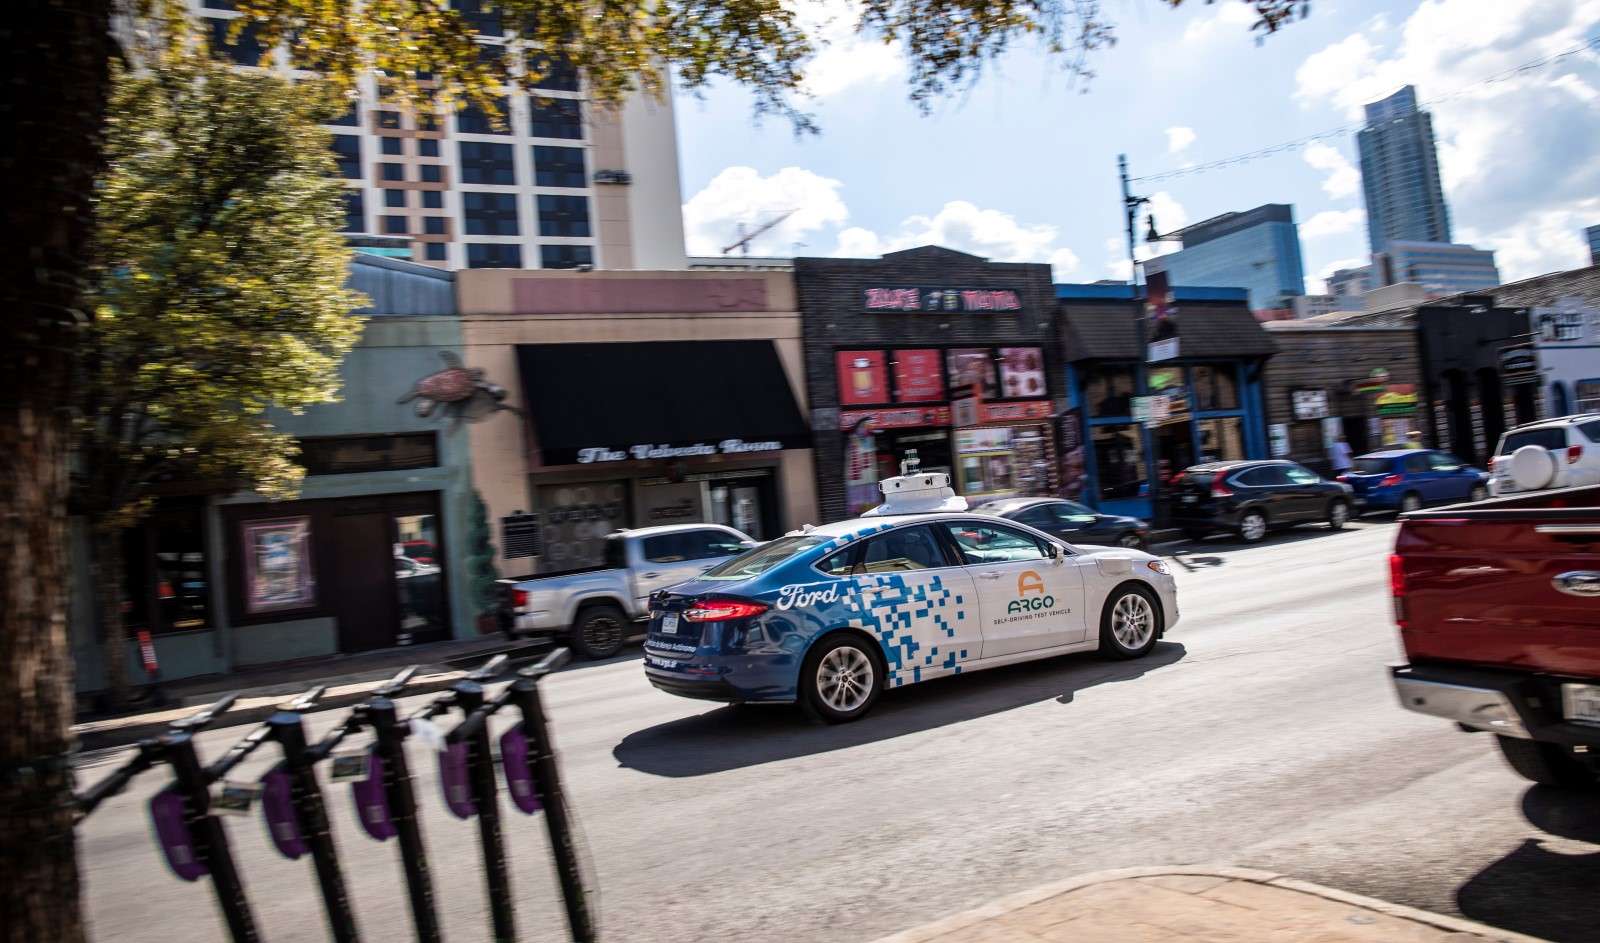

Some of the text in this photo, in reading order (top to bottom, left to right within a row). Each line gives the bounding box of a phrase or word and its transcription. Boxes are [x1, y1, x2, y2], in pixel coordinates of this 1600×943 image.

[577, 447, 627, 463] The
[719, 439, 783, 454] Room
[776, 583, 840, 610] Ford
[1008, 595, 1054, 614] ARGO
[993, 614, 1033, 625] SELF-DRIVING
[1048, 608, 1071, 616] VEHICLE
